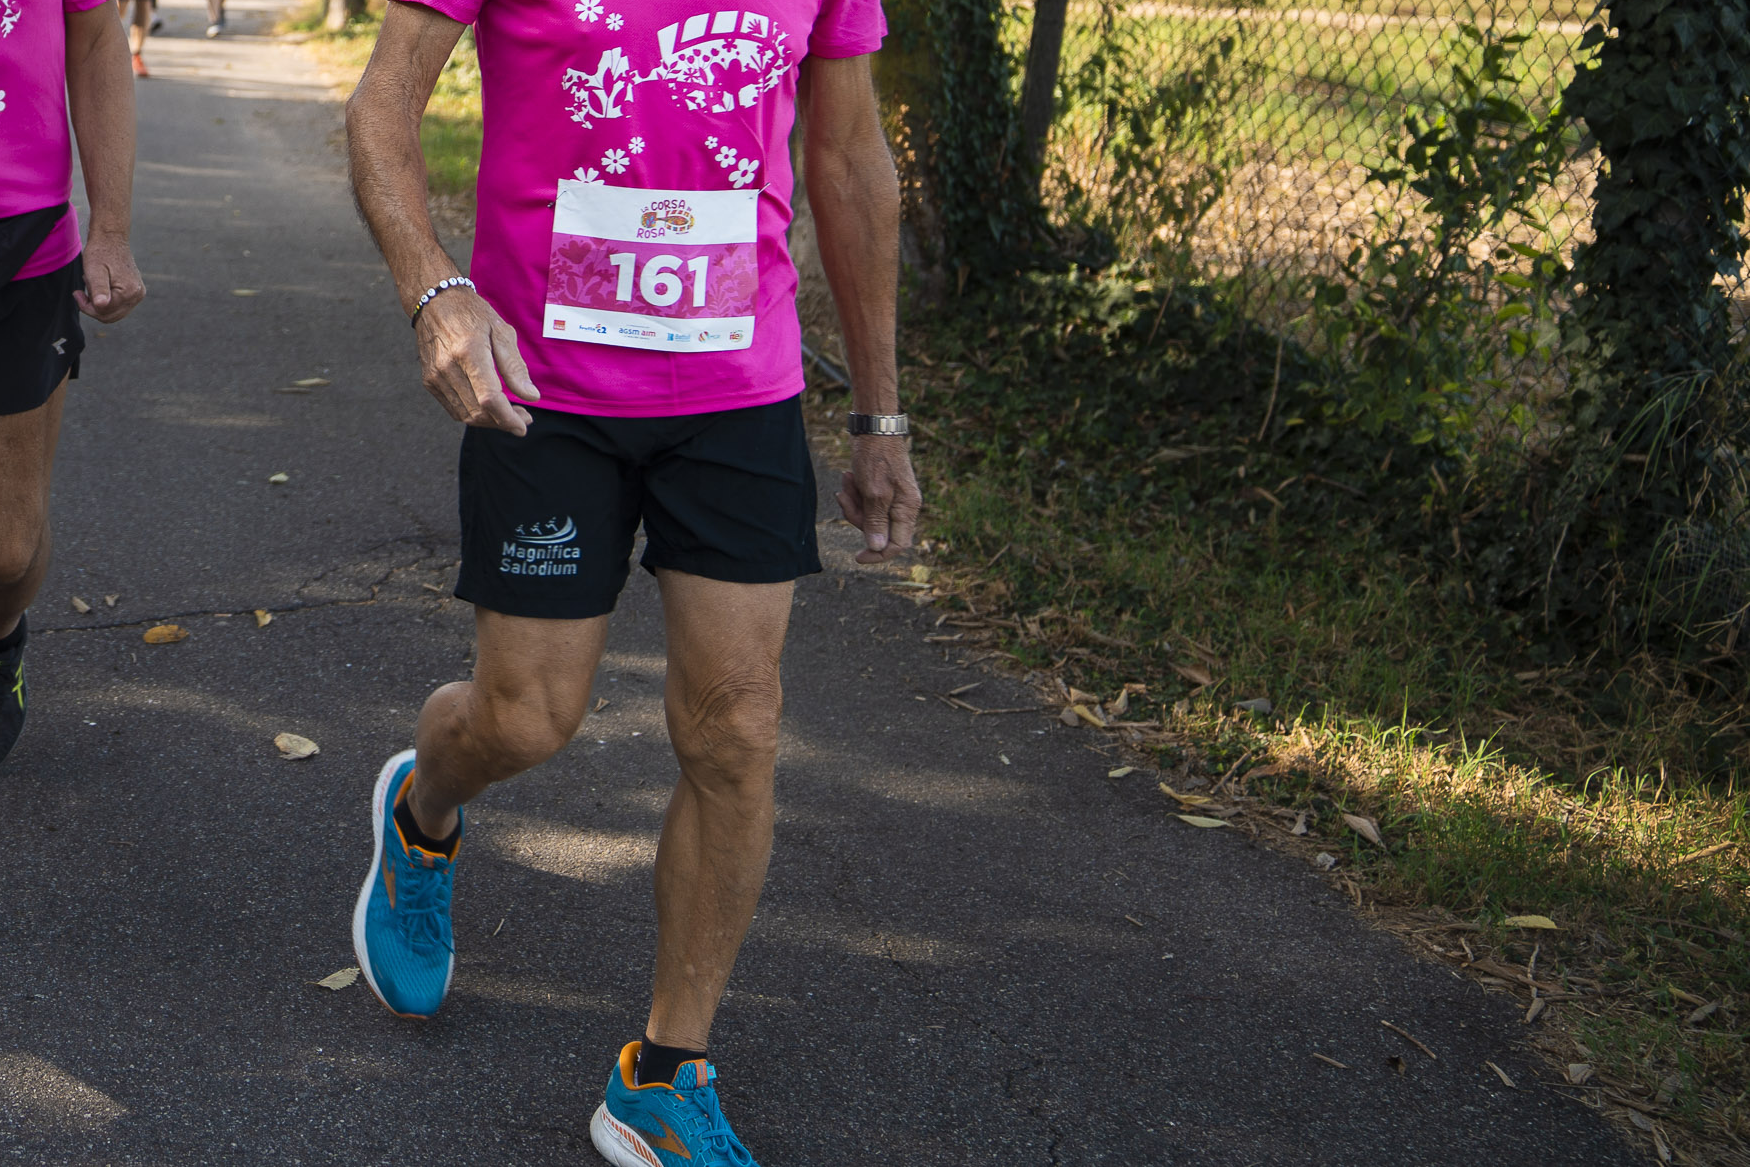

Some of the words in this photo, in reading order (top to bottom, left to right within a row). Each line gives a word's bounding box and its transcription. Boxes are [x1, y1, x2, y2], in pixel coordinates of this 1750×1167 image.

[650, 199, 686, 211] CORSA
[636, 227, 666, 239] ROSA
[609, 252, 710, 308] 161
[502, 541, 581, 563] Magnifica
[499, 558, 578, 576] Salodium
